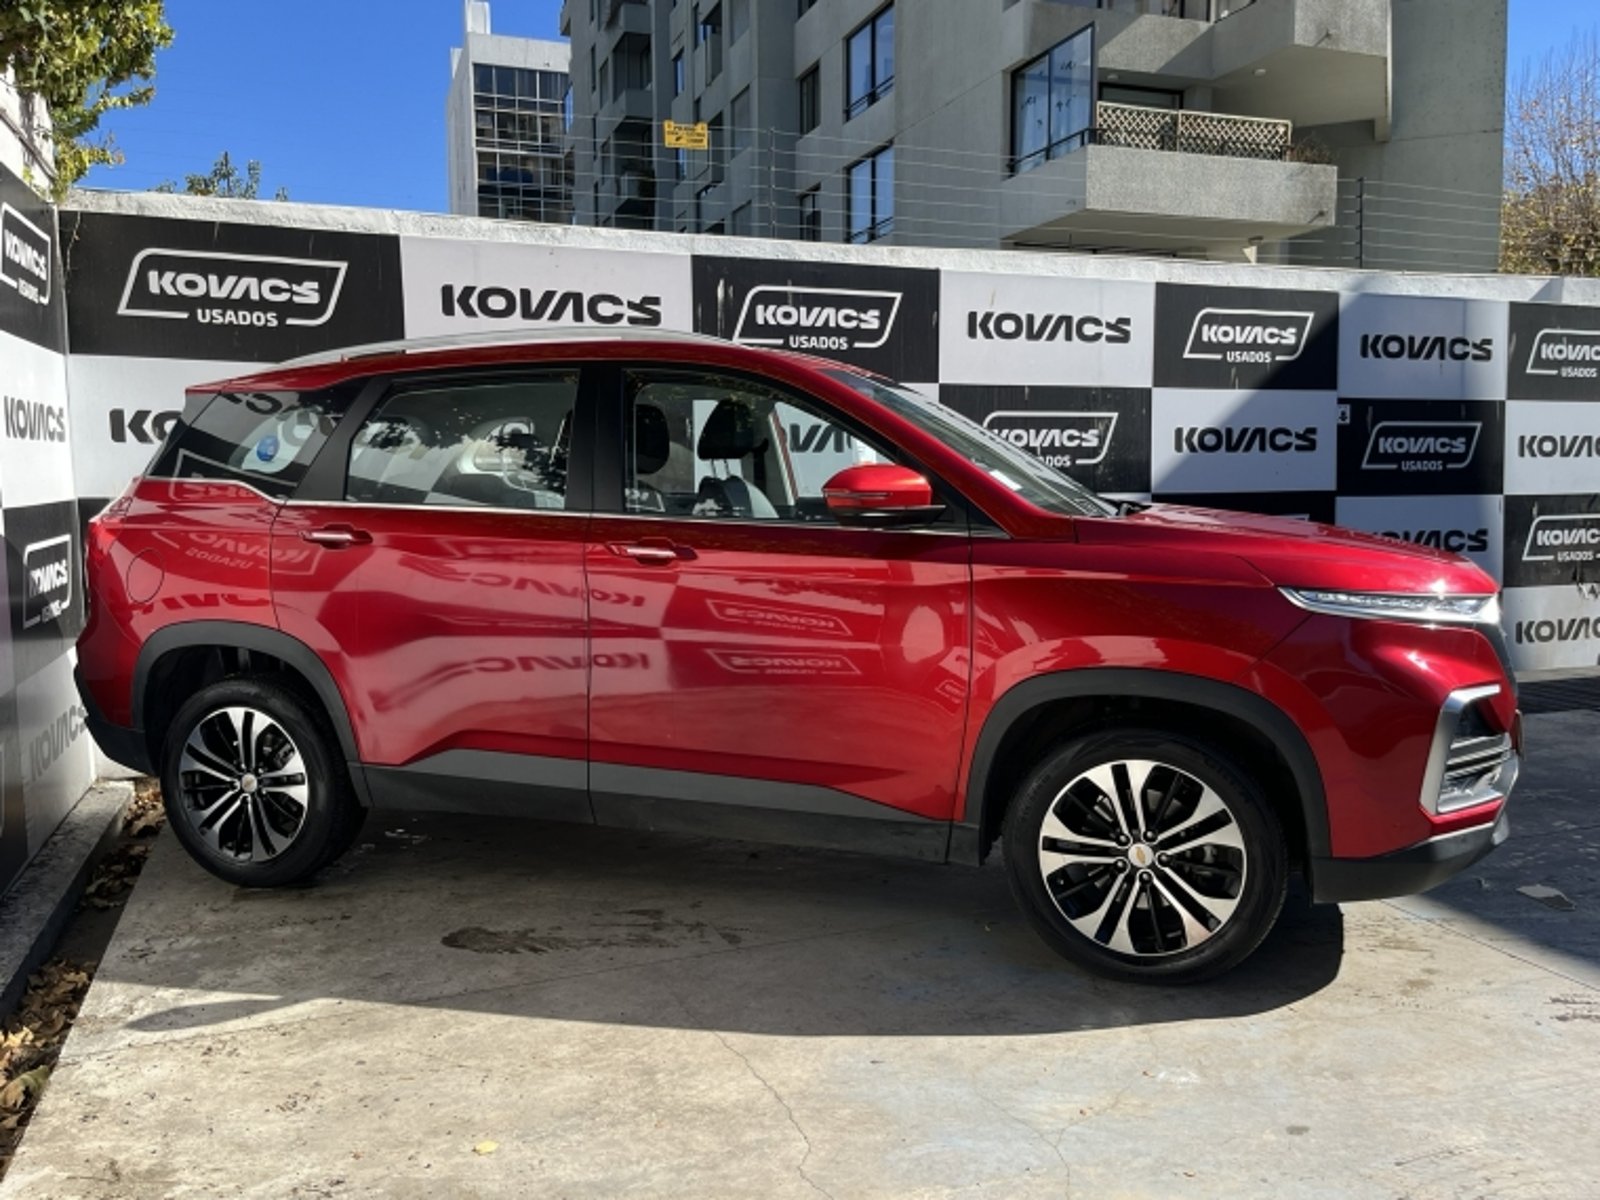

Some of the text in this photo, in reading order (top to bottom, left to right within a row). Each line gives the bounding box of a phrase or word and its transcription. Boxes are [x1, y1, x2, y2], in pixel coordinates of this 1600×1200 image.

[4, 229, 47, 281] KOVACS
[147, 270, 320, 304] KOVACS
[441, 284, 662, 326] KOVACS
[756, 304, 880, 330] KOVACS
[197, 309, 278, 327] USADOS
[967, 311, 1132, 344] KOVACS
[789, 335, 848, 350] USADOS
[1201, 324, 1297, 344] KOVACS
[1226, 351, 1272, 363] USADOS
[1360, 334, 1493, 361] KOVACS
[4, 395, 66, 442] KOVACS
[1173, 426, 1318, 453] KOVACS
[1378, 436, 1467, 454] KOVACS
[1518, 435, 1600, 458] KOVA
[1401, 460, 1443, 471] USADOS
[1373, 529, 1489, 553] VACS
